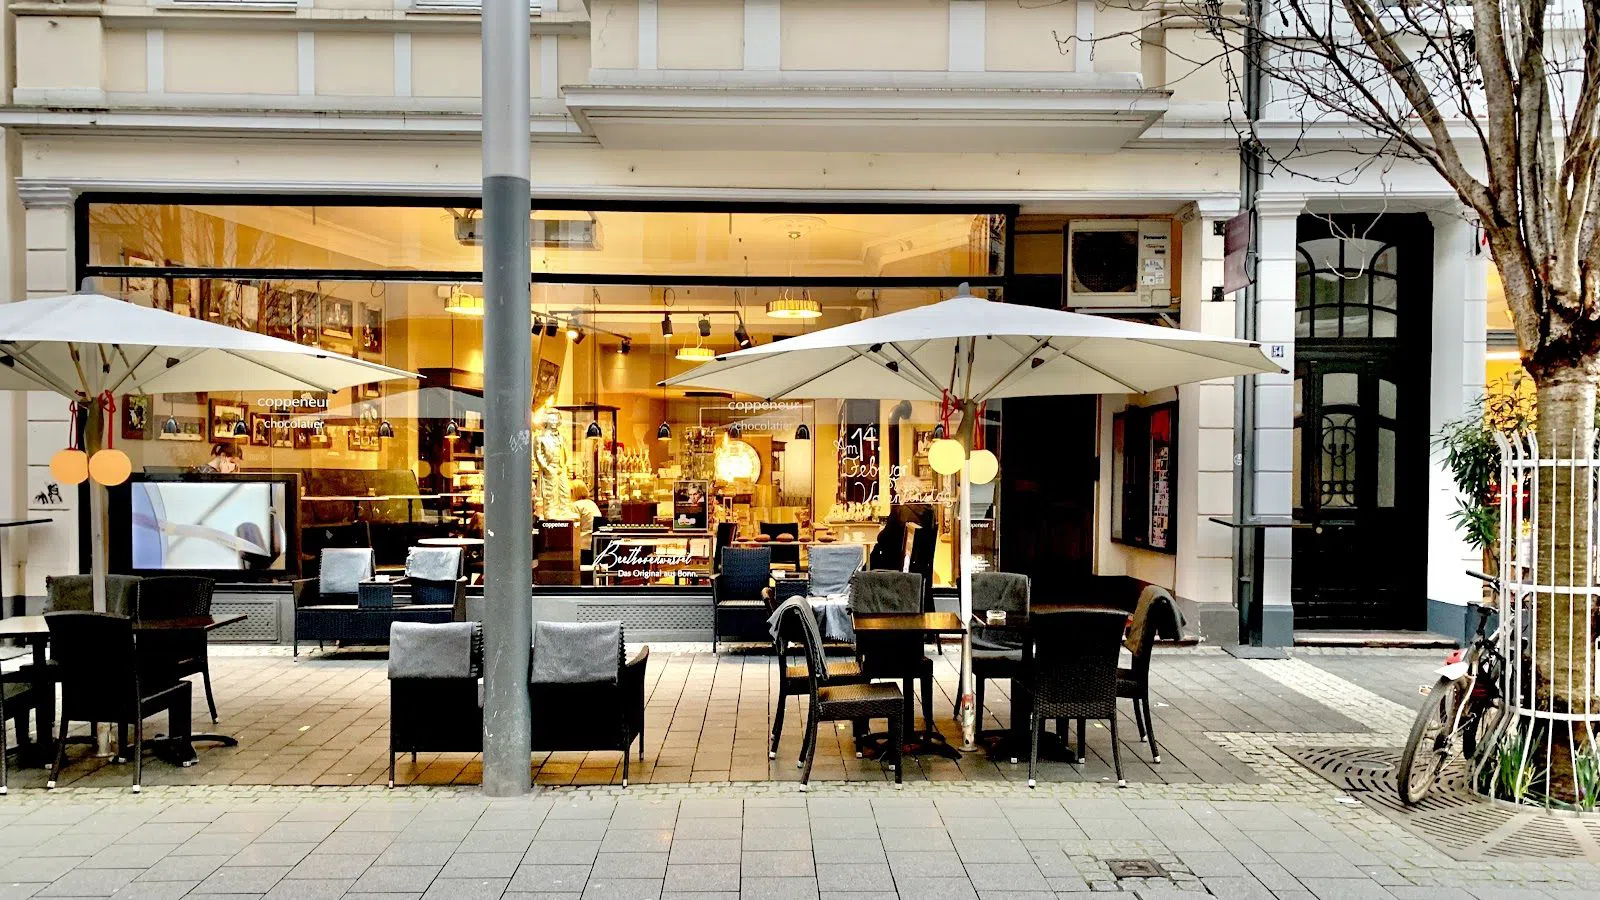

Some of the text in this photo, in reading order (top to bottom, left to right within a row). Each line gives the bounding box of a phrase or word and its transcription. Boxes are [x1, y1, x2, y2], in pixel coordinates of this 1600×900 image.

[257, 398, 330, 411] coppeneur
[727, 401, 800, 413] coppeneur
[264, 417, 324, 429] chocolatier
[735, 420, 793, 431] chocolatier
[833, 436, 859, 456] Am
[841, 455, 907, 477] Febuar
[854, 481, 953, 507] Vaentinstag
[617, 569, 632, 578] Das
[632, 569, 662, 579] Original
[677, 569, 699, 578] Bonn.
